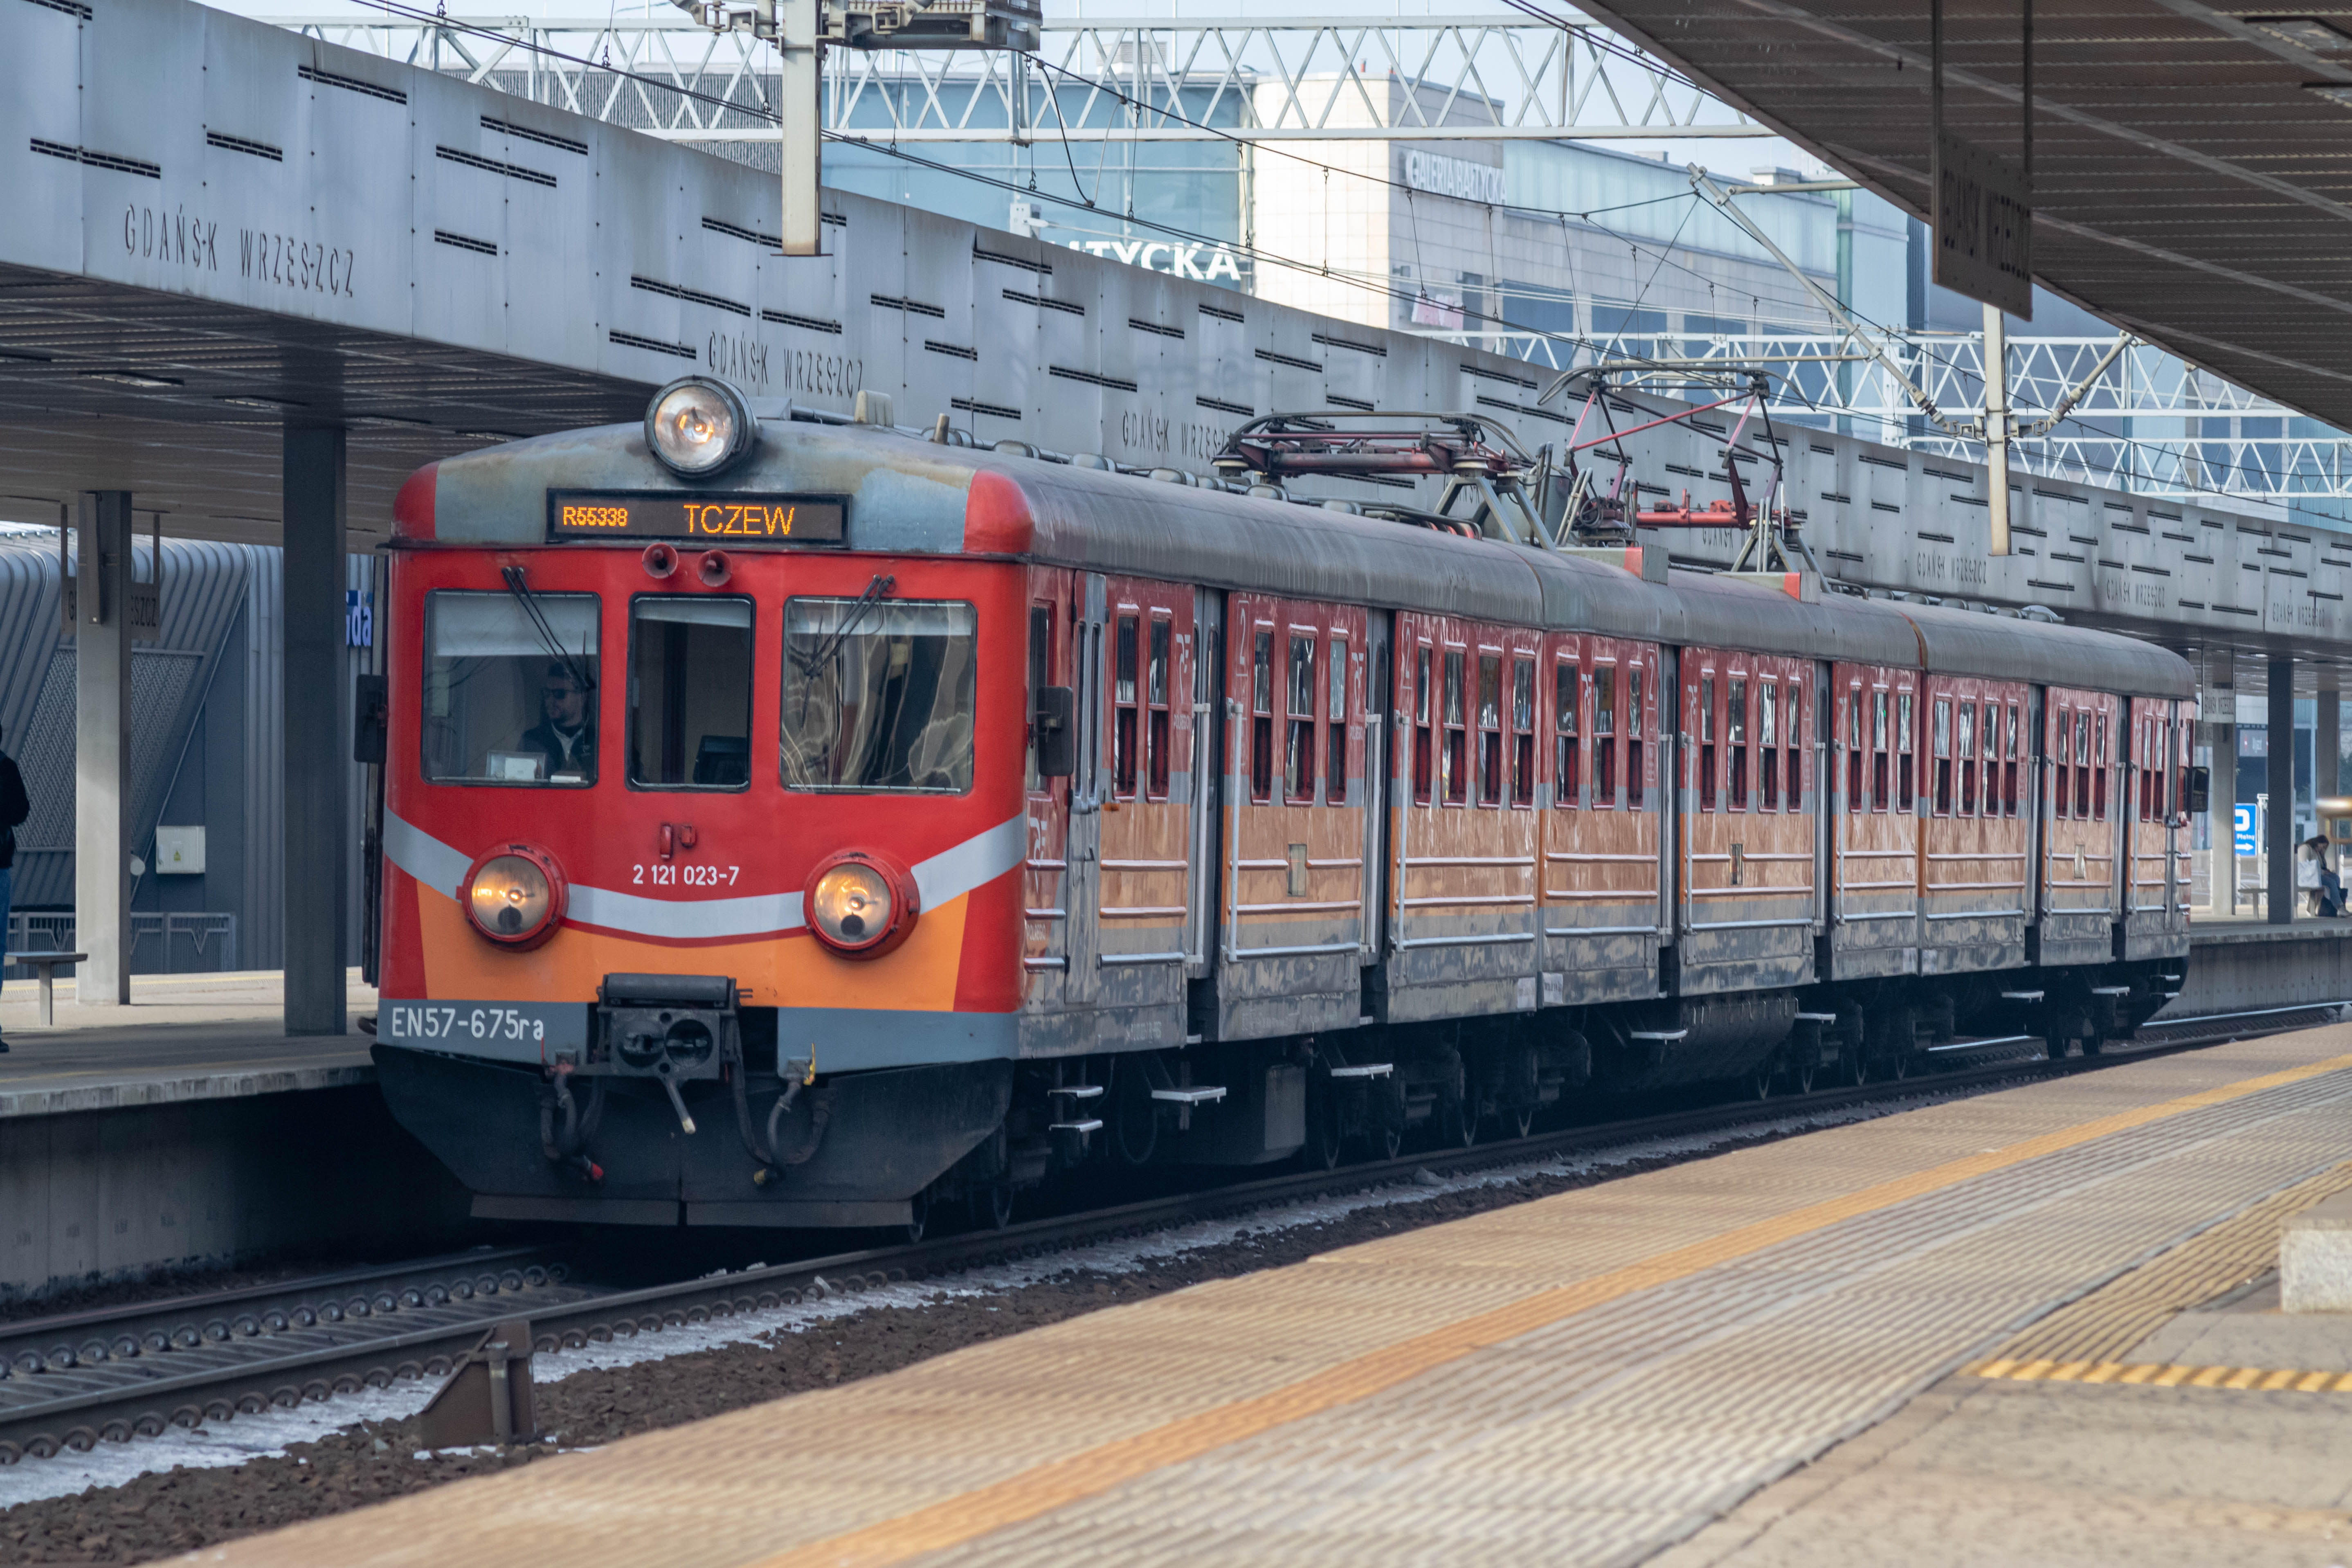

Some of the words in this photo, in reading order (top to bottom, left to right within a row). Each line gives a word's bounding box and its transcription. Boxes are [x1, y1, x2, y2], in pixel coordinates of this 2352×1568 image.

[1409, 150, 1453, 196] GALERIA
[125, 204, 216, 271] GDAŃSK
[241, 228, 353, 297] WRZESZCZ
[709, 331, 768, 385] GDAŃSK
[784, 347, 862, 399] WRZESZCZ
[1123, 408, 1169, 452] GDAŃSK
[1181, 421, 1226, 461] WRZESZ
[563, 506, 628, 526] R55338
[684, 504, 795, 535] TCZEW
[1917, 549, 1945, 579] GDAŃSK
[1951, 556, 1987, 584] WRZESZCZ
[1240, 608, 1246, 665] 2
[1405, 626, 1410, 679] 2
[1649, 655, 1653, 701] 2
[633, 864, 644, 884] 2
[651, 864, 675, 885] 121
[684, 865, 740, 886] 023-7
[392, 1007, 544, 1041] EN57-675ra
